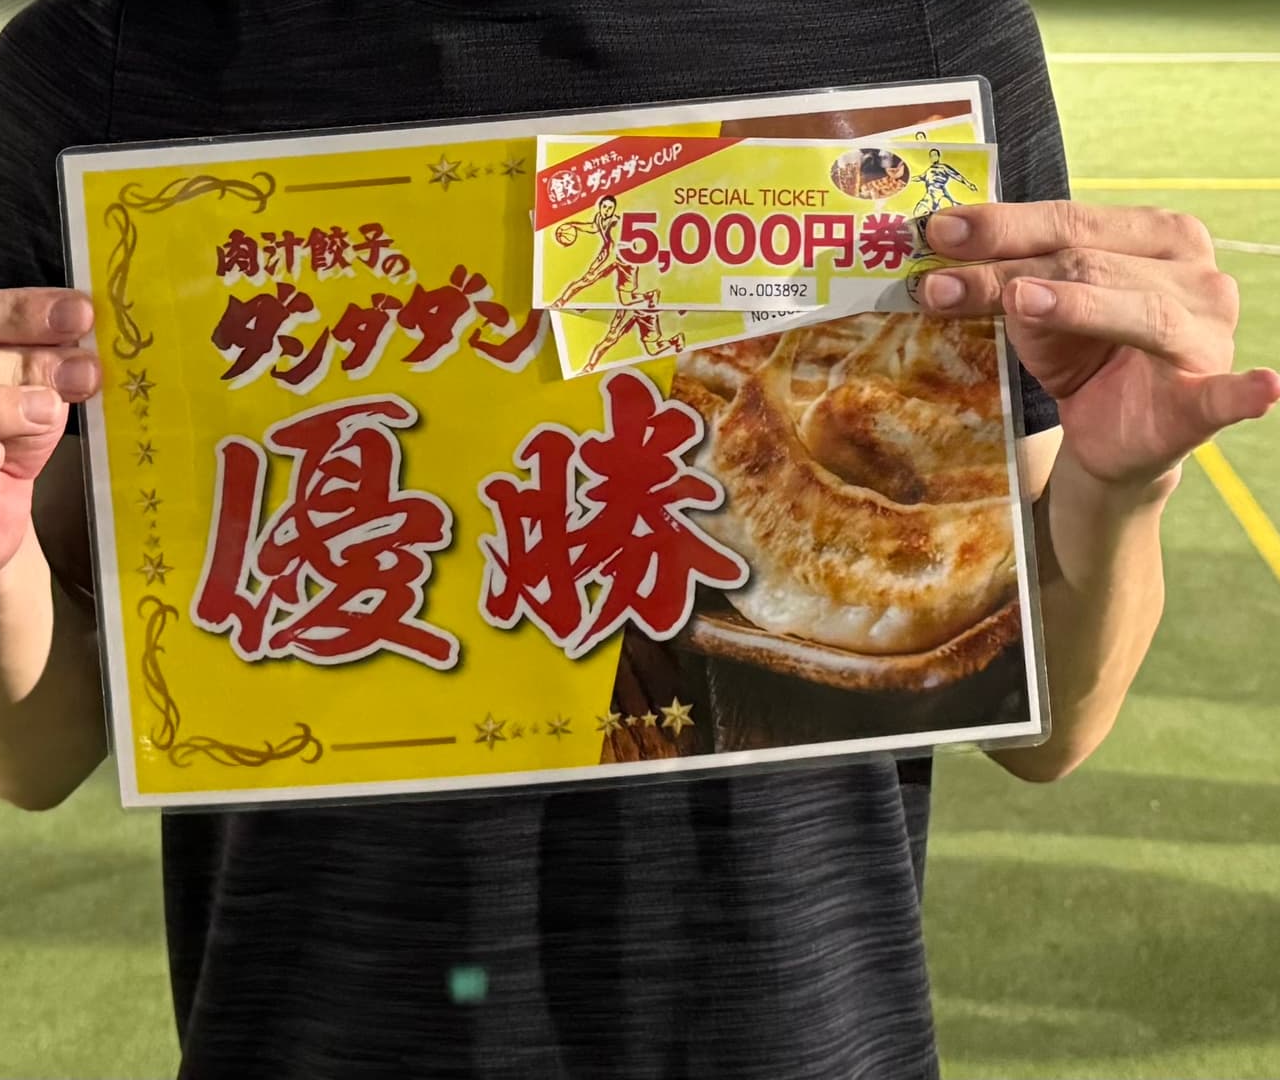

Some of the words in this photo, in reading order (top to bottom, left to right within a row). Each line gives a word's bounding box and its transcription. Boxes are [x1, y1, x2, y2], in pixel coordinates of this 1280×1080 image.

[673, 187, 755, 206] SPECIAL
[759, 188, 830, 207] TICKET
[215, 223, 412, 278] 肉汁餃子の
[621, 212, 914, 272] 5,000円券
[729, 283, 808, 298] No.003892
[211, 264, 547, 384] ダンダダン
[192, 370, 747, 667] 優勝
